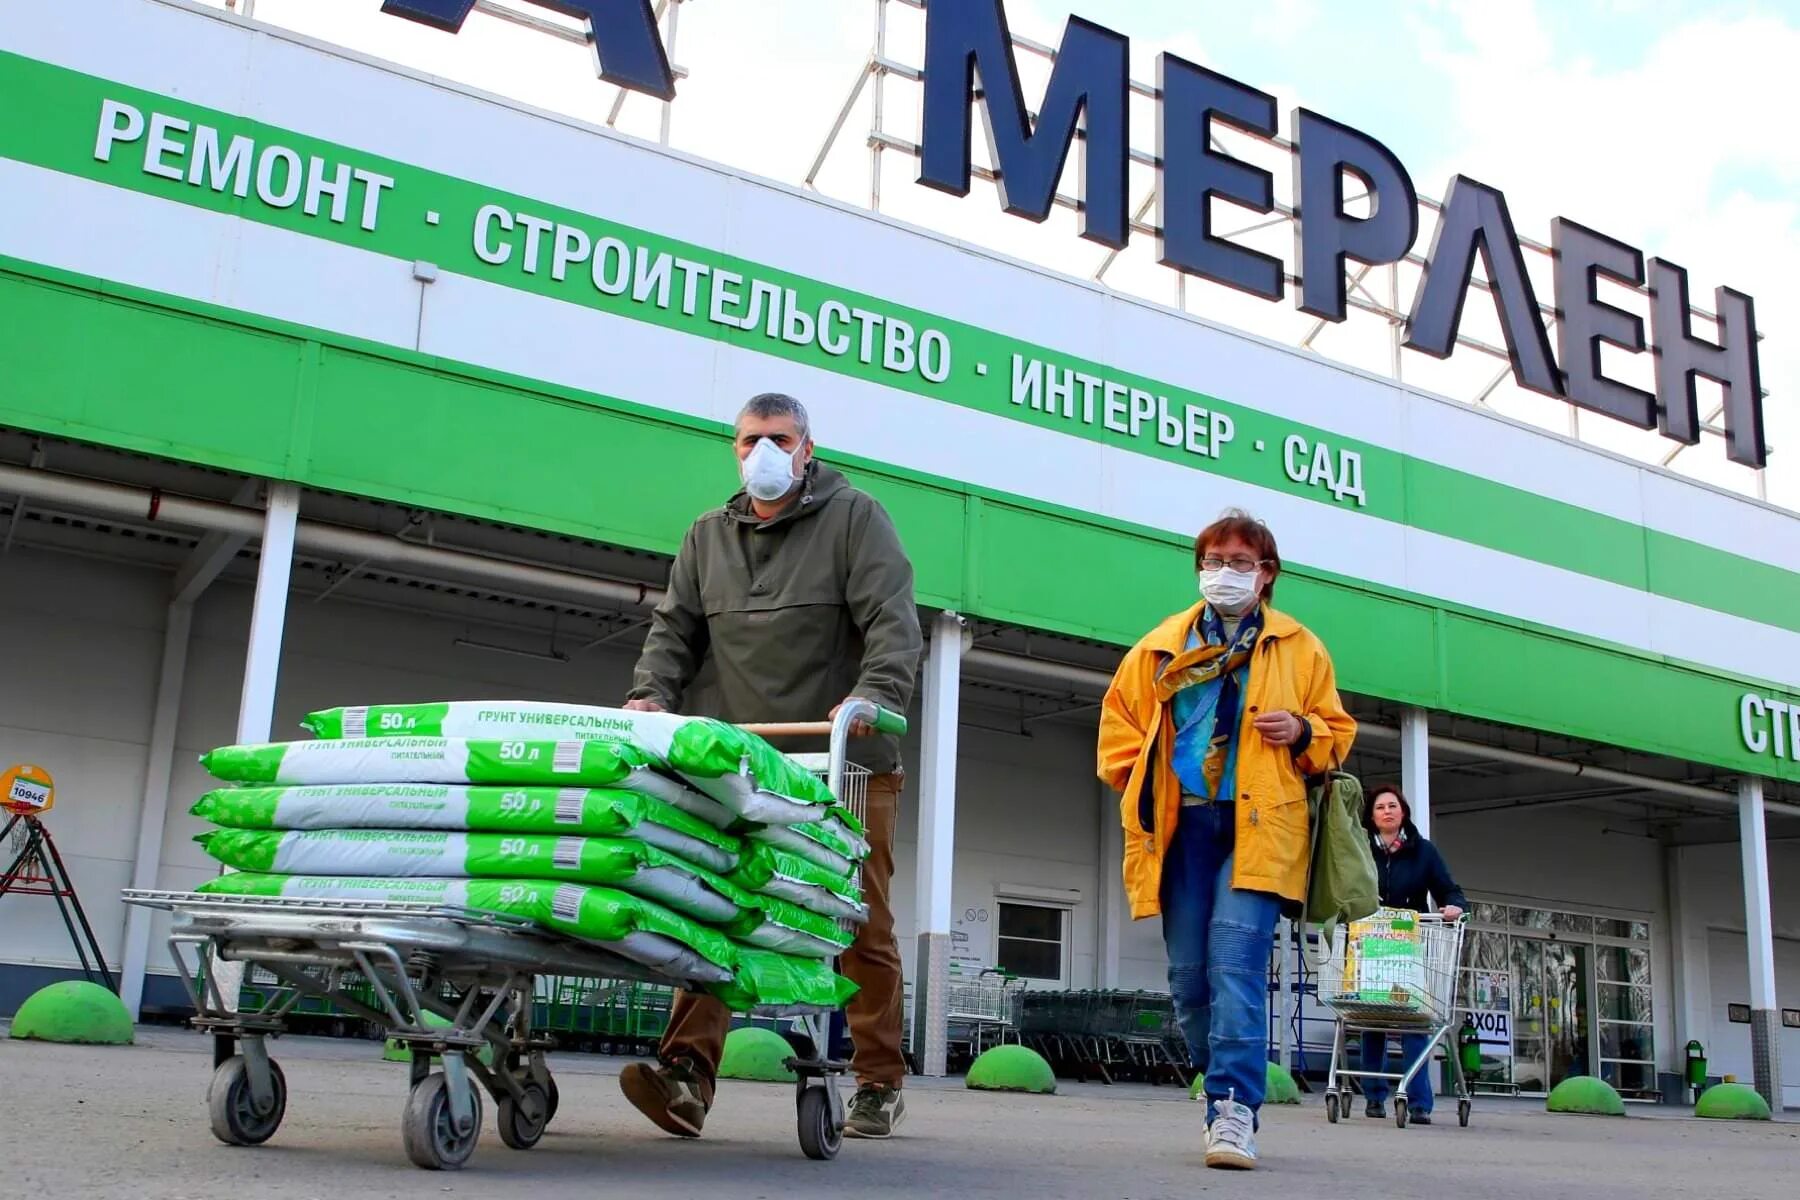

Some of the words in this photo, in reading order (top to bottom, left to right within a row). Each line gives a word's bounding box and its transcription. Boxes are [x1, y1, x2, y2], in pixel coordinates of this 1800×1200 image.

[914, 0, 1767, 469] МЕРЛЕН
[94, 98, 395, 232] РЕМОНТ
[472, 204, 952, 384] СТРОИТЕЛЬСТВО
[1011, 353, 1235, 459] ИНТЕРЬЕР
[1284, 434, 1366, 506] САД
[380, 712, 403, 730] 50
[478, 710, 516, 723] ГРУНТ
[519, 711, 634, 732] УНИВЕРСАЛЬНЫЙ
[499, 741, 525, 760] 50
[528, 747, 540, 760] л
[14, 787, 45, 803] 10946
[500, 792, 527, 811] 50
[500, 838, 525, 855] 50
[501, 885, 525, 903] 50
[1465, 1012, 1508, 1037] ВХОД
